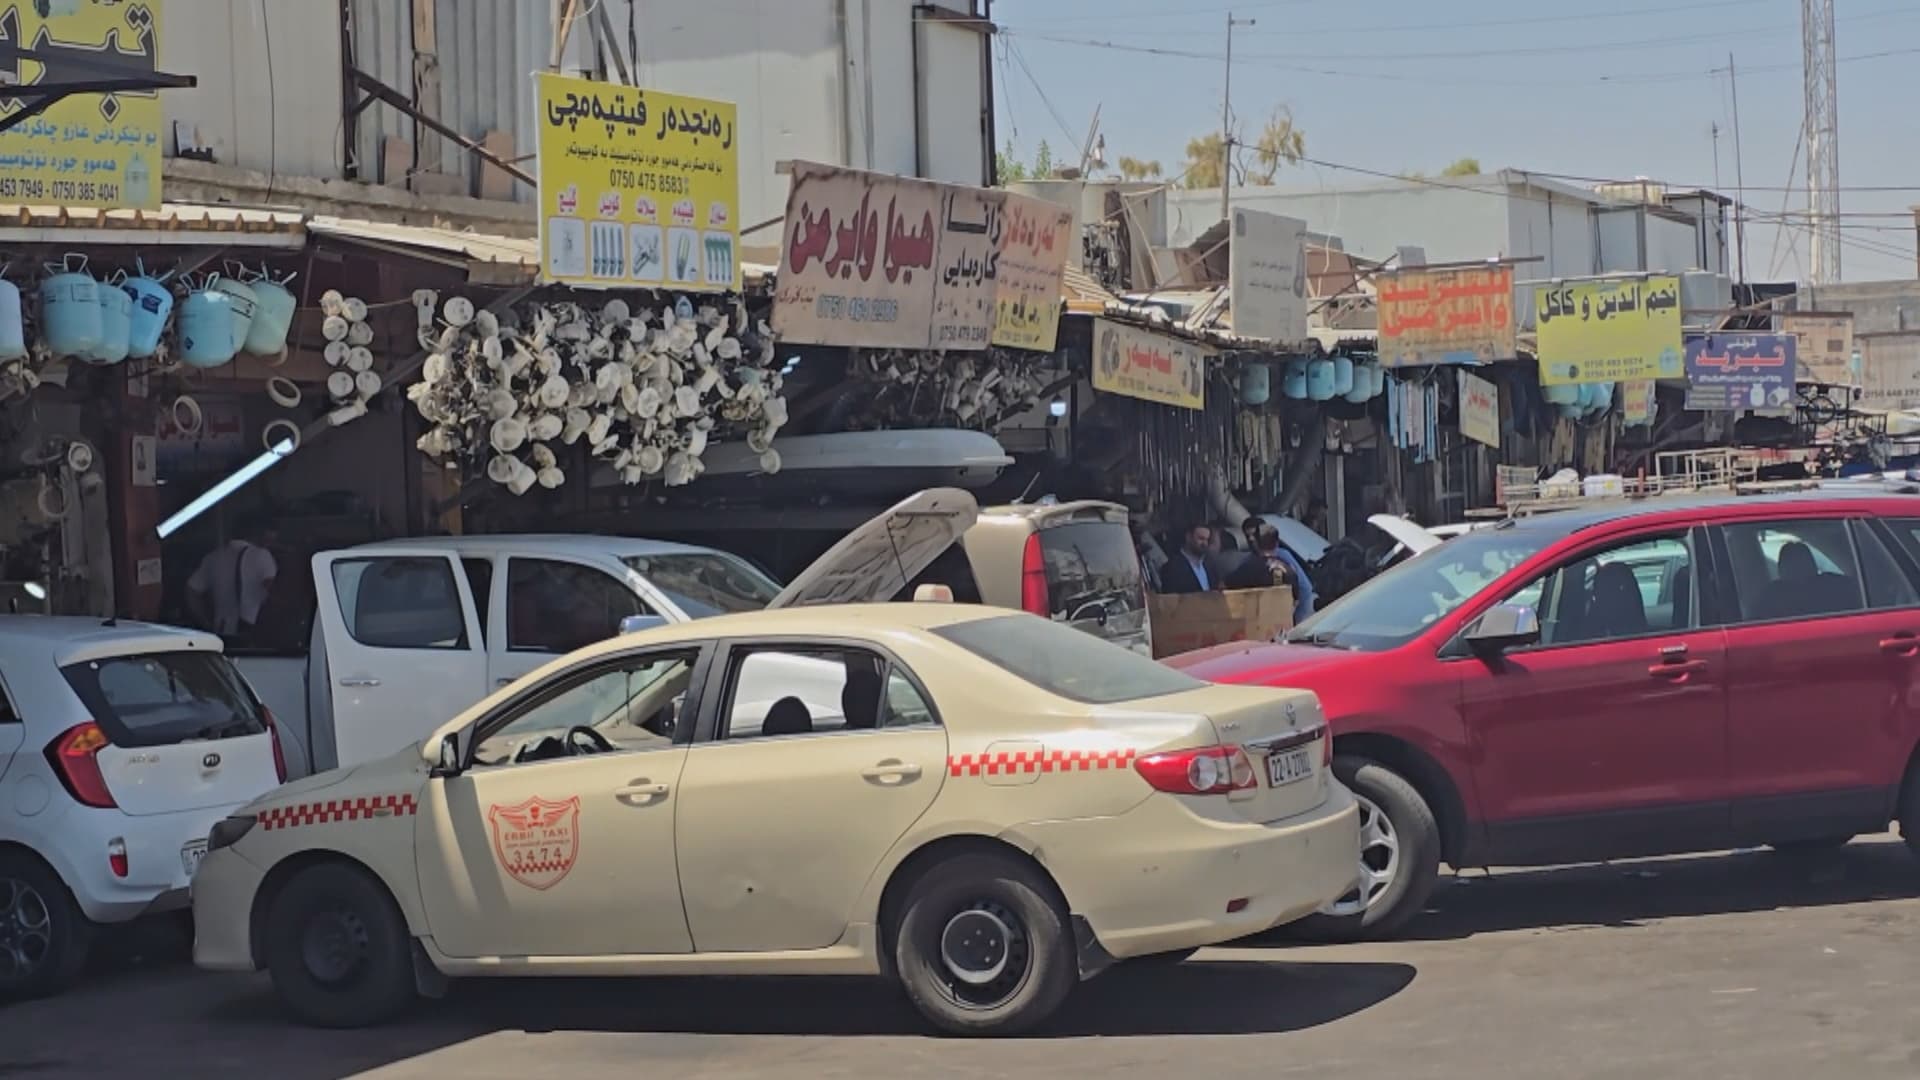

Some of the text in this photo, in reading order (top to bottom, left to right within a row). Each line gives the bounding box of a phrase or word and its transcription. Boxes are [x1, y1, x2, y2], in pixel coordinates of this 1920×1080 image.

[19, 179, 43, 198] 7949
[52, 181, 75, 201] 0750
[78, 183, 95, 201] 385
[98, 184, 119, 203] 4041
[610, 169, 683, 194] 0750 475 8583
[542, 828, 568, 838] TAXI
[513, 848, 562, 864] 3474
